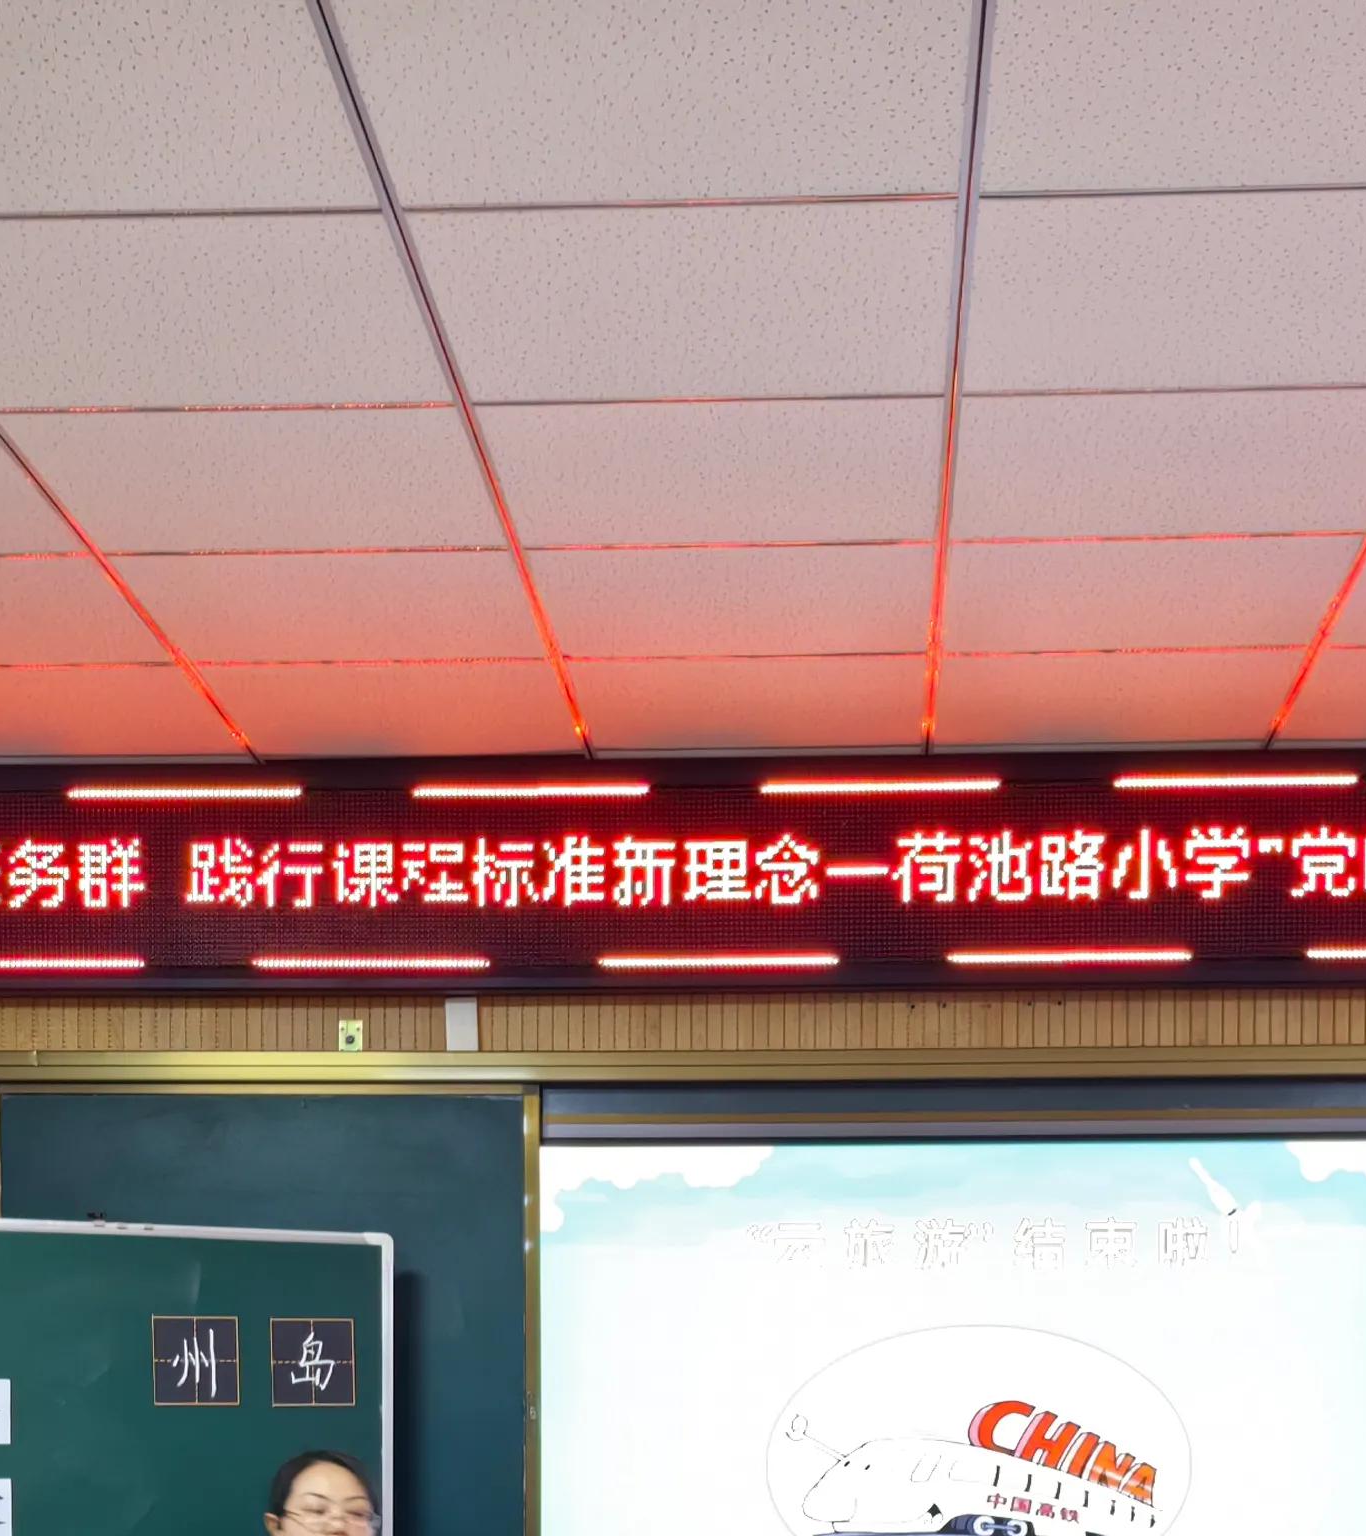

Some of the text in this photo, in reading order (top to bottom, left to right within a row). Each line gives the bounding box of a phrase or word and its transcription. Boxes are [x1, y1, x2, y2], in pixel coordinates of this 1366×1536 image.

[172, 1328, 337, 1398] 州 岛
[968, 1400, 1157, 1508] CHINA
